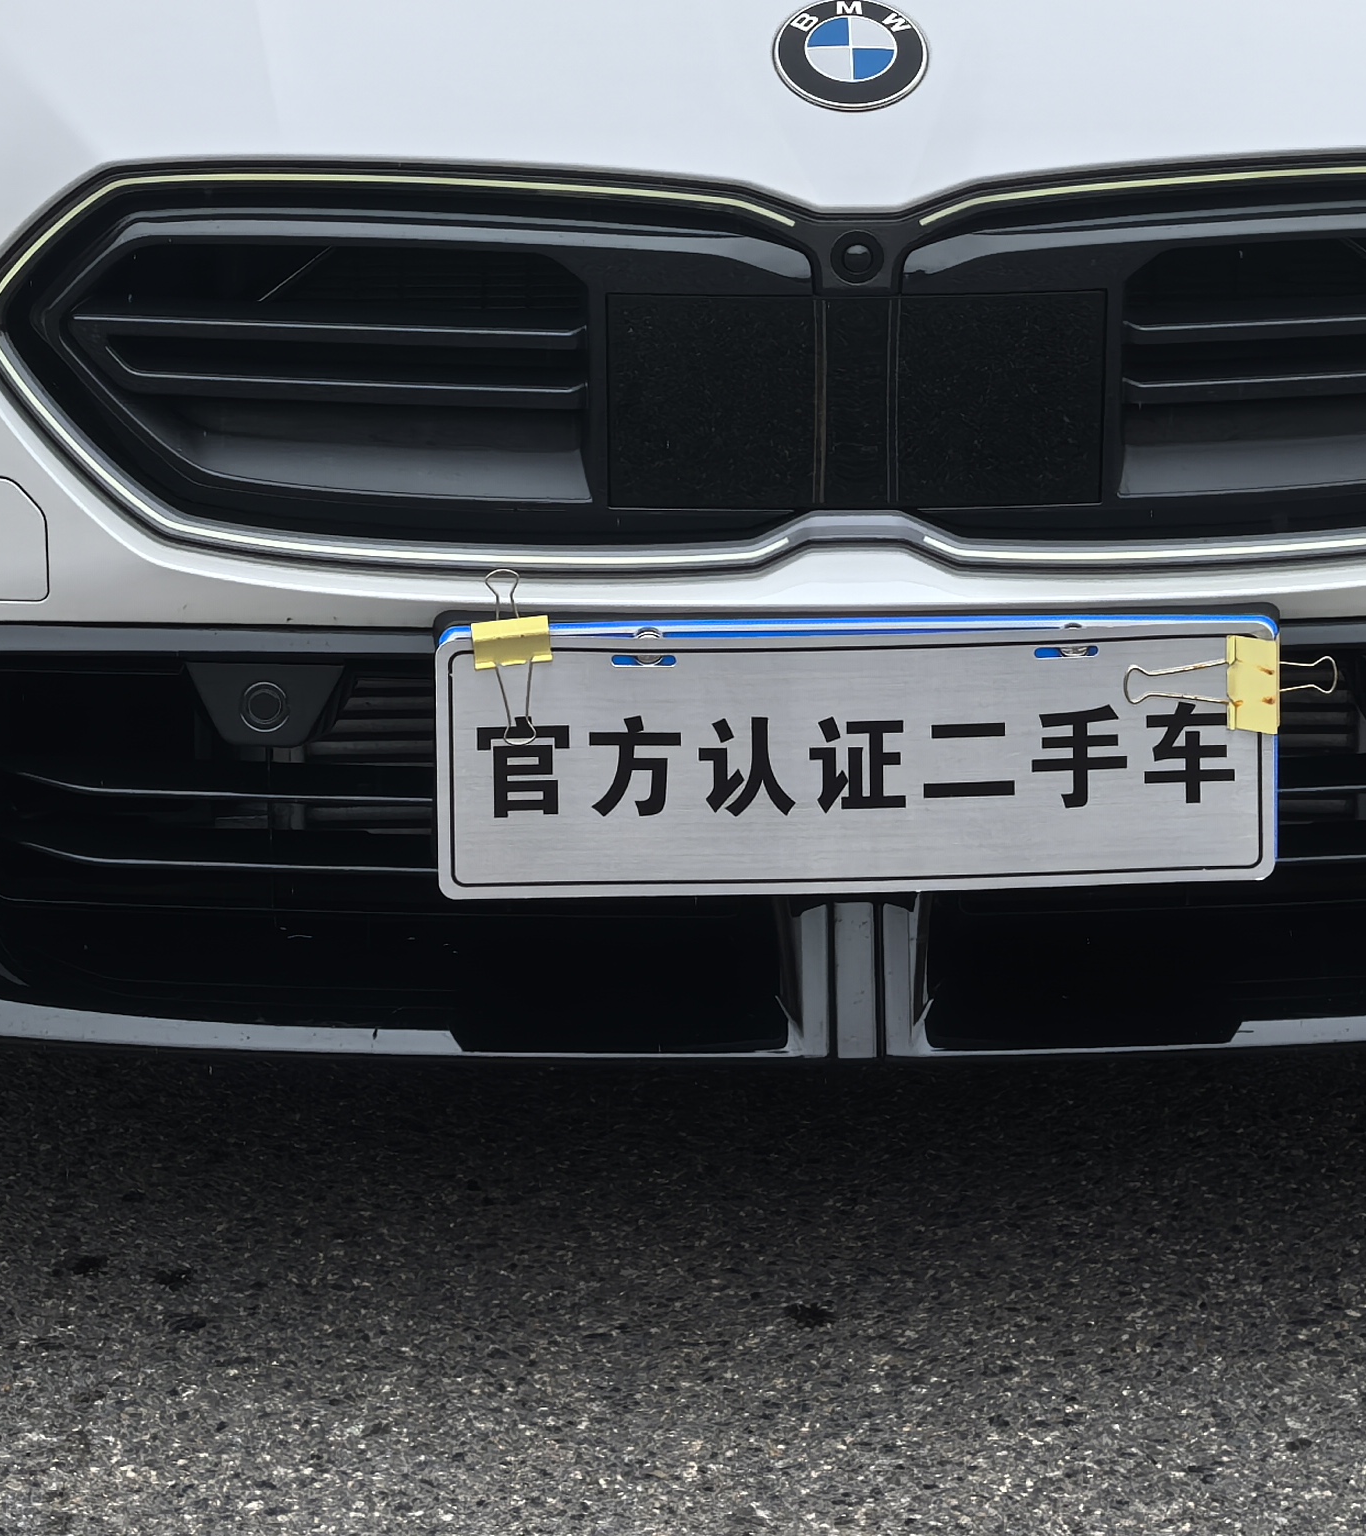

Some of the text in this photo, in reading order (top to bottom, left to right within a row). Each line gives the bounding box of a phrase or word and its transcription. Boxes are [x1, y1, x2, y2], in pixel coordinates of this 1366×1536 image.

[790, 1, 912, 32] BMW
[475, 703, 1237, 819] 官方认证二手车
